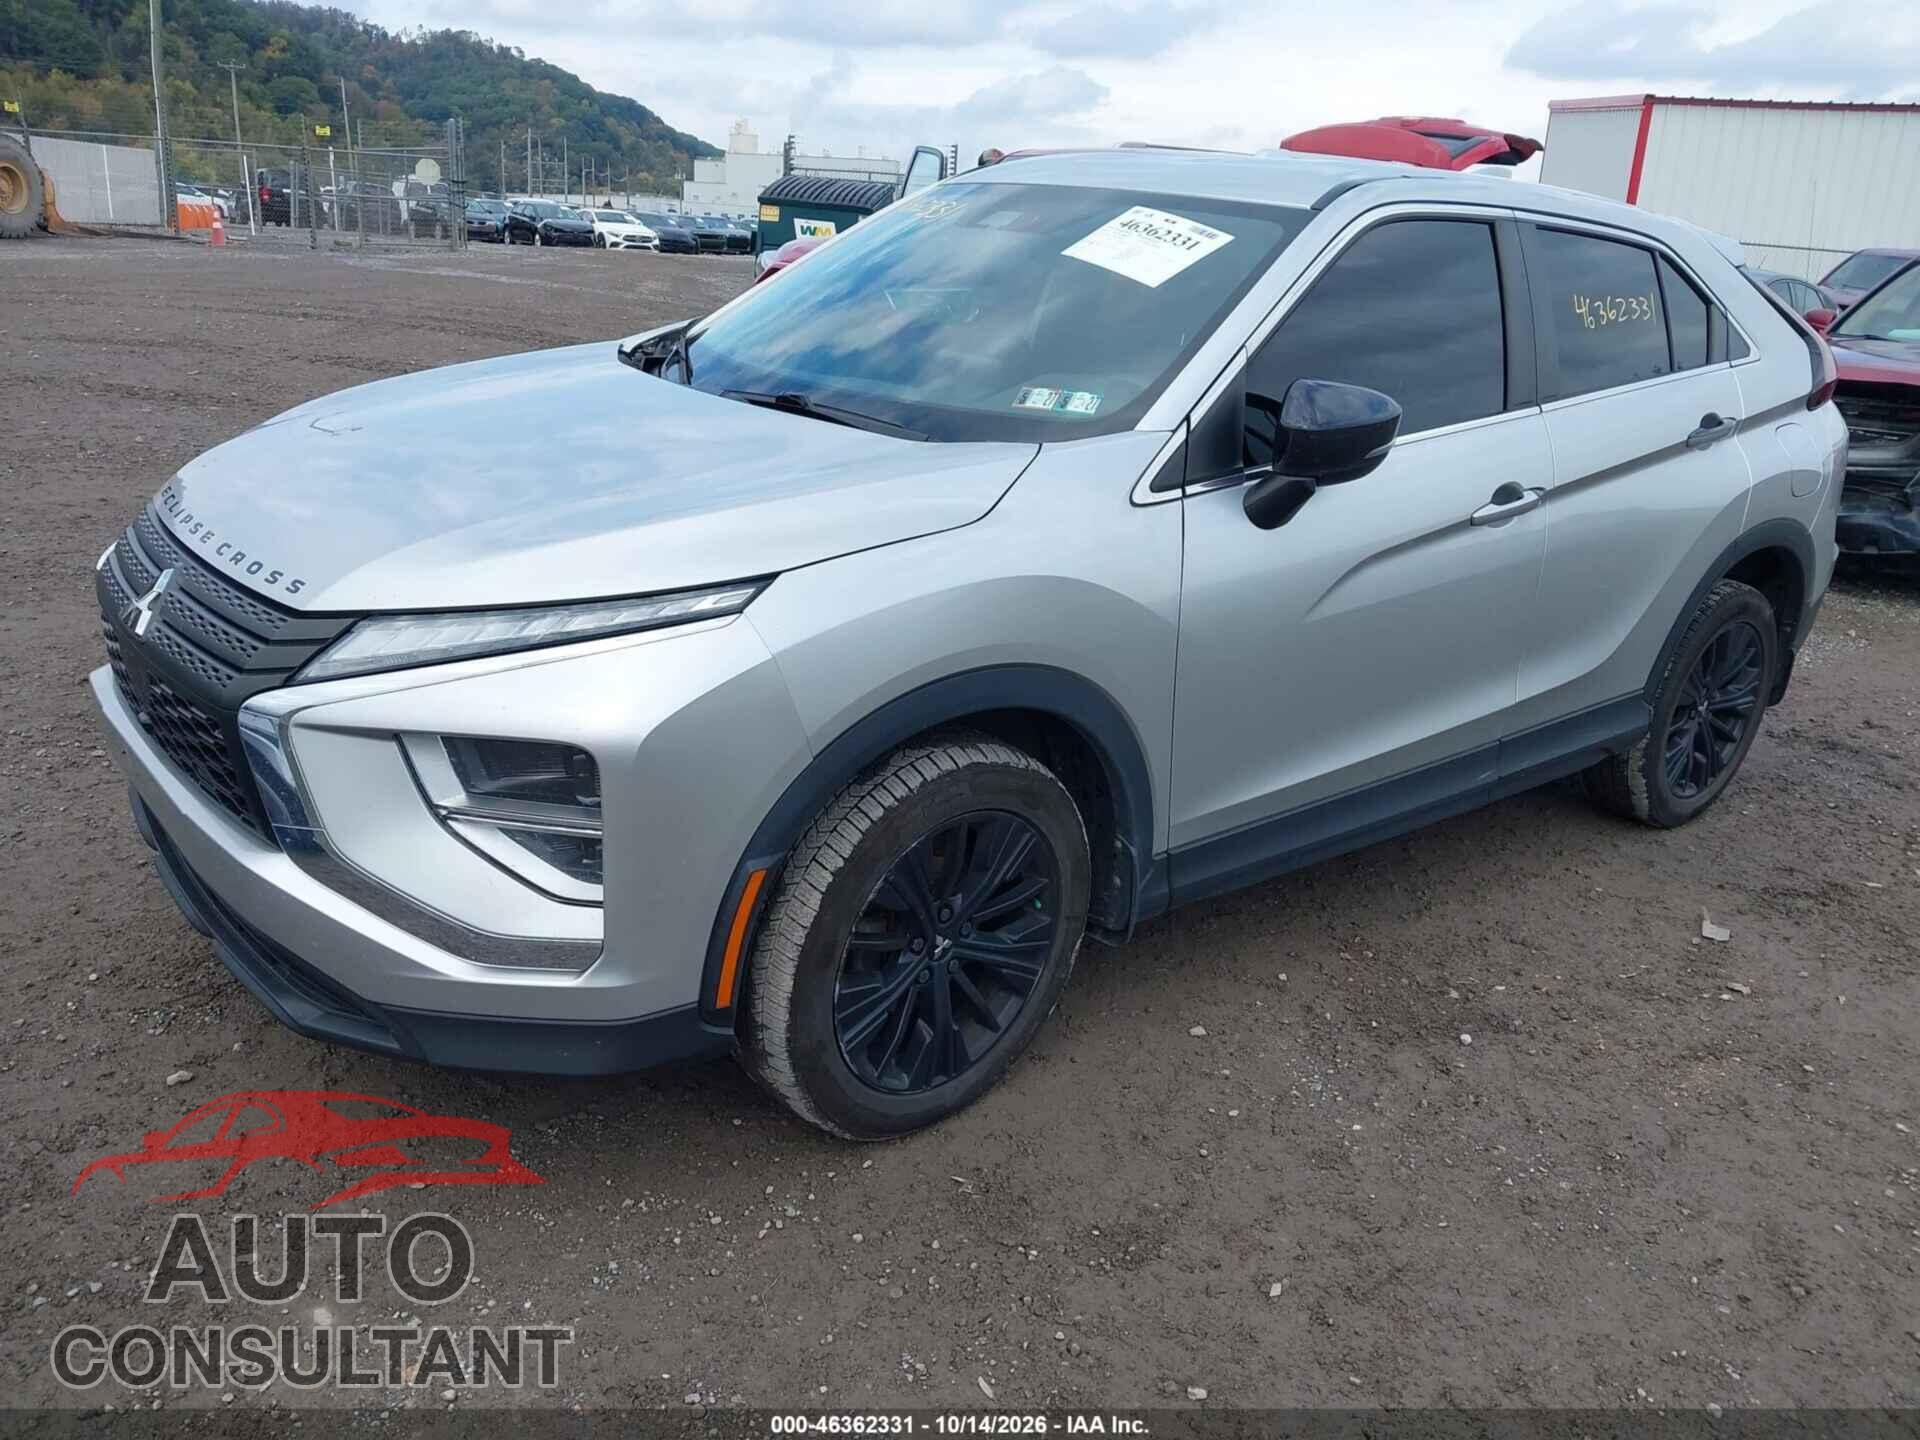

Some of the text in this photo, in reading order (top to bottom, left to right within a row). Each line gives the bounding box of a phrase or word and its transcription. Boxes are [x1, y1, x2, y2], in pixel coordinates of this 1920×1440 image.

[800, 225, 832, 237] WM
[1120, 219, 1200, 251] 46362331
[1573, 289, 1656, 329] 46362331
[161, 486, 307, 594] ECLIPSE CROSS
